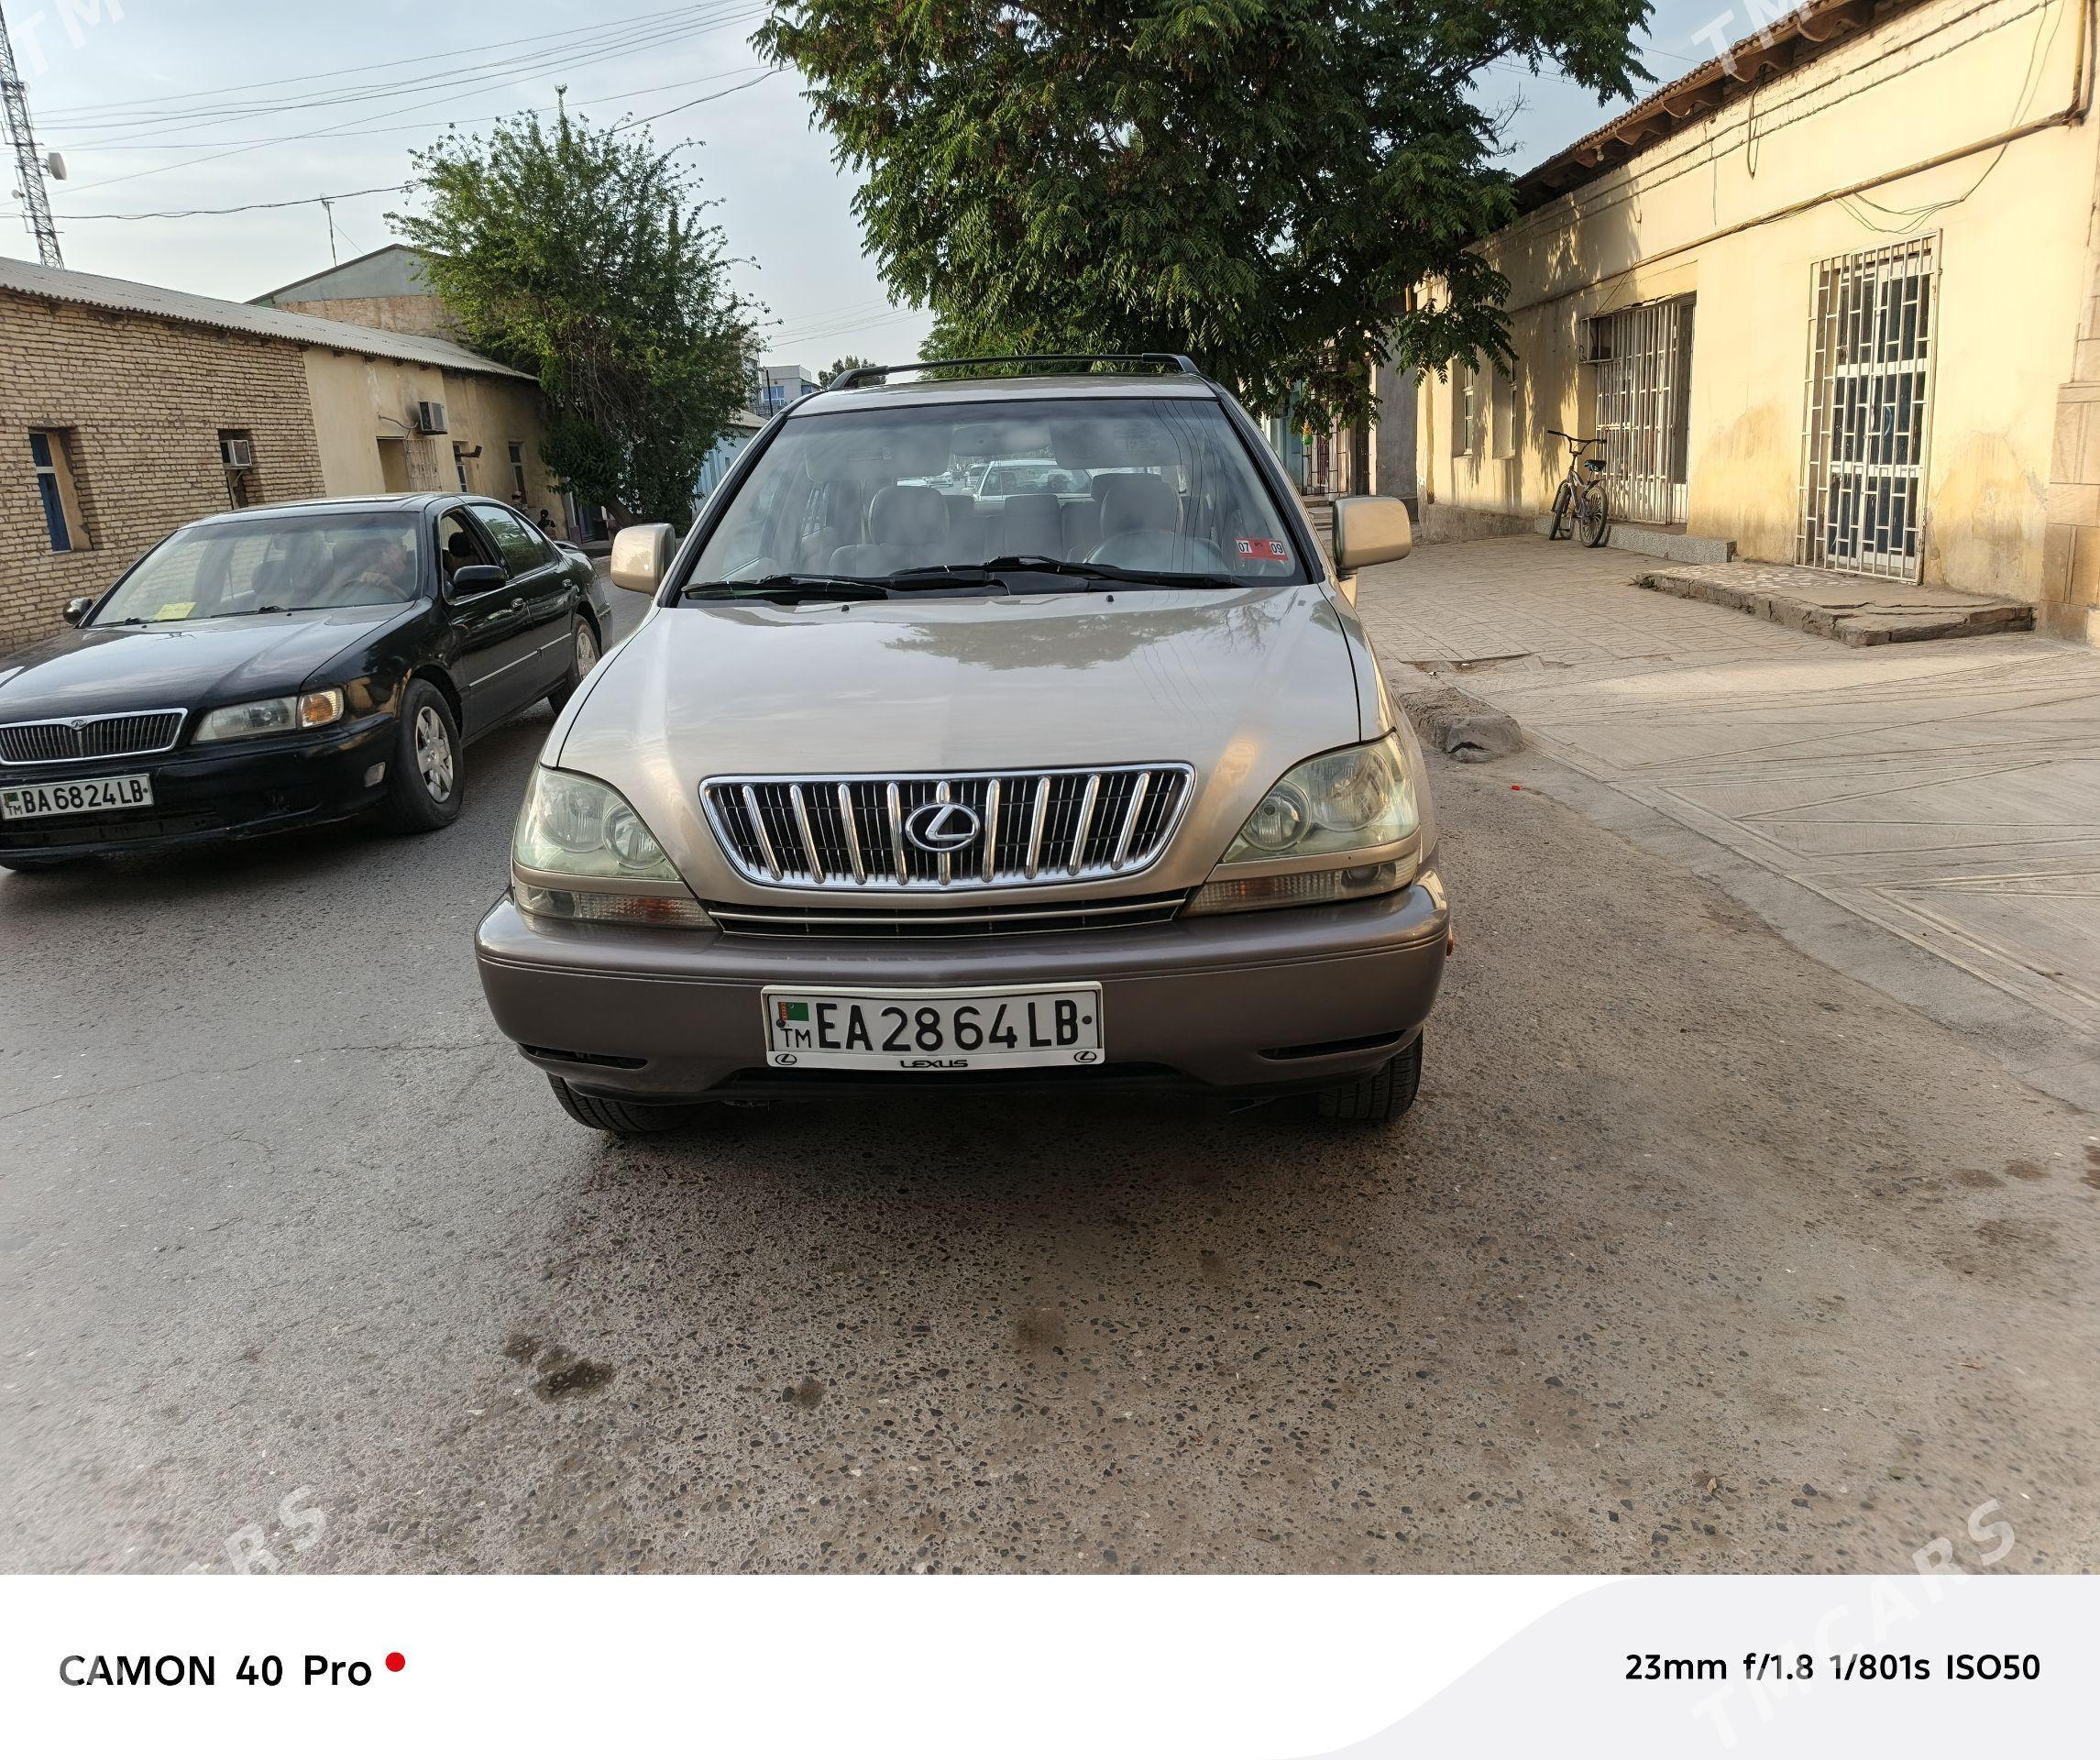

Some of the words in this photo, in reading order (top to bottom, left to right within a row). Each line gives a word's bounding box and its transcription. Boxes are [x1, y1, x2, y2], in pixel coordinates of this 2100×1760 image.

[1237, 542, 1249, 553] 07
[1270, 543, 1283, 554] 09
[780, 1028, 812, 1049] TM
[816, 999, 1079, 1052] EA2864LB
[900, 1060, 969, 1068] LEXUS
